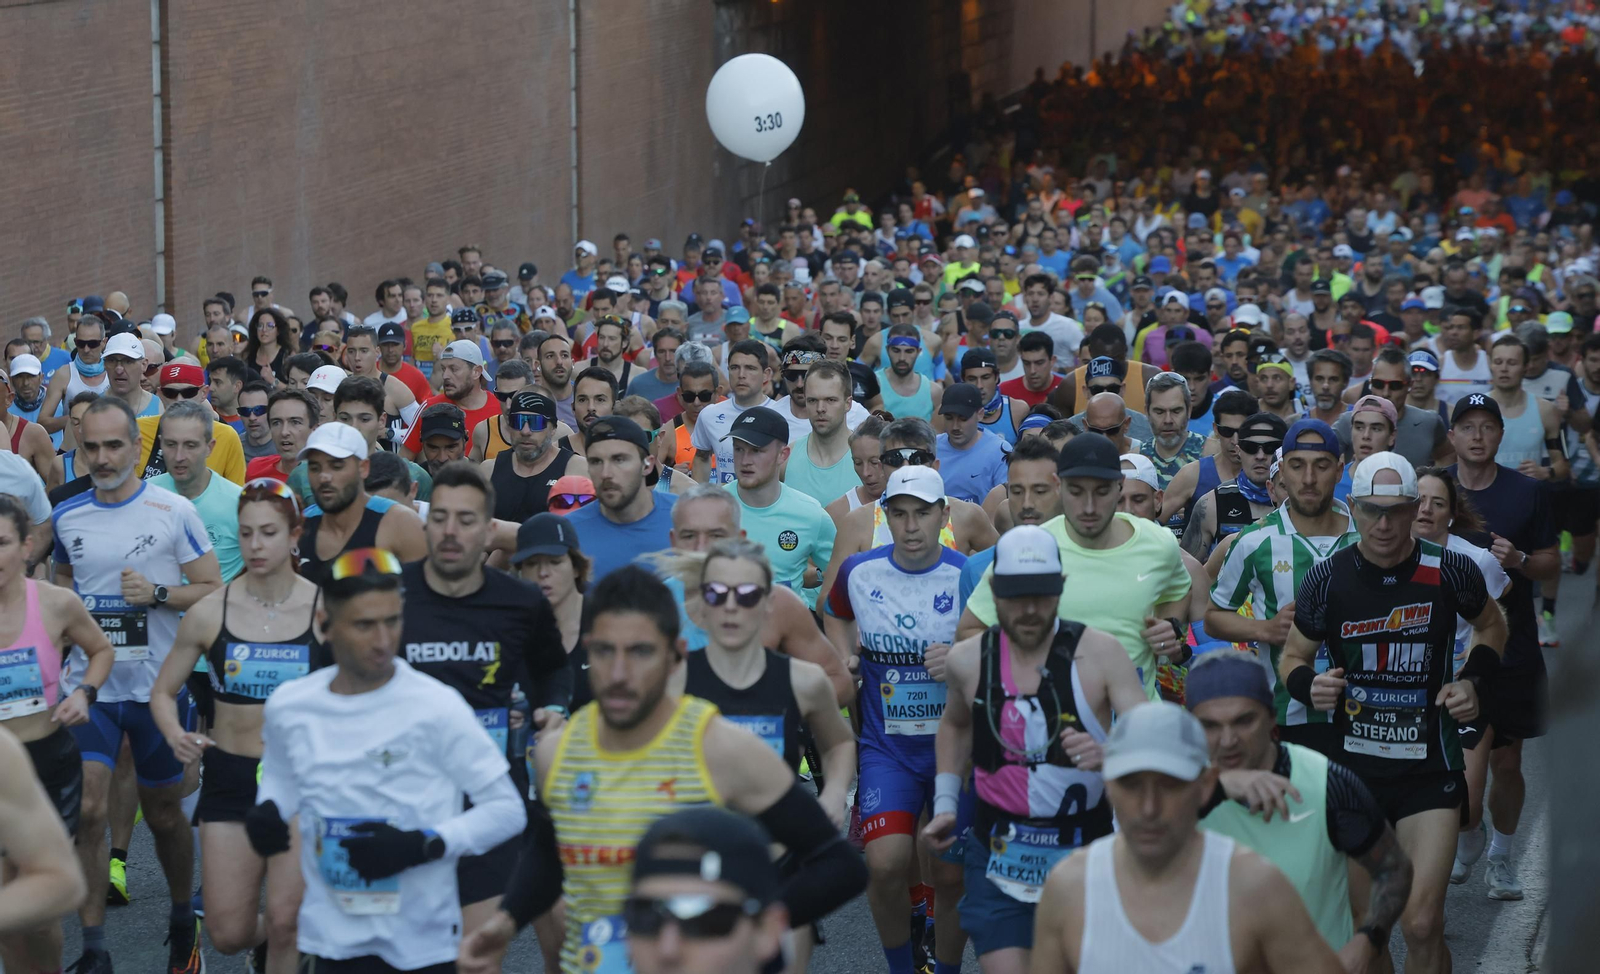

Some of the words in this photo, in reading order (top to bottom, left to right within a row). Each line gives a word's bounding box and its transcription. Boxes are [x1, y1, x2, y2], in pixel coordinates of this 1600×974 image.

[755, 112, 782, 132] 3:30
[100, 618, 122, 628] 3125
[895, 613, 916, 629] 10
[254, 648, 300, 659] ZURICH
[255, 670, 279, 680] 4742
[905, 671, 933, 681] ZURI
[232, 682, 278, 697] ANTIG
[906, 691, 928, 701] 7201
[1372, 693, 1417, 703] ZURICH
[1374, 712, 1397, 723] 4175
[1352, 721, 1419, 741] STEFANO
